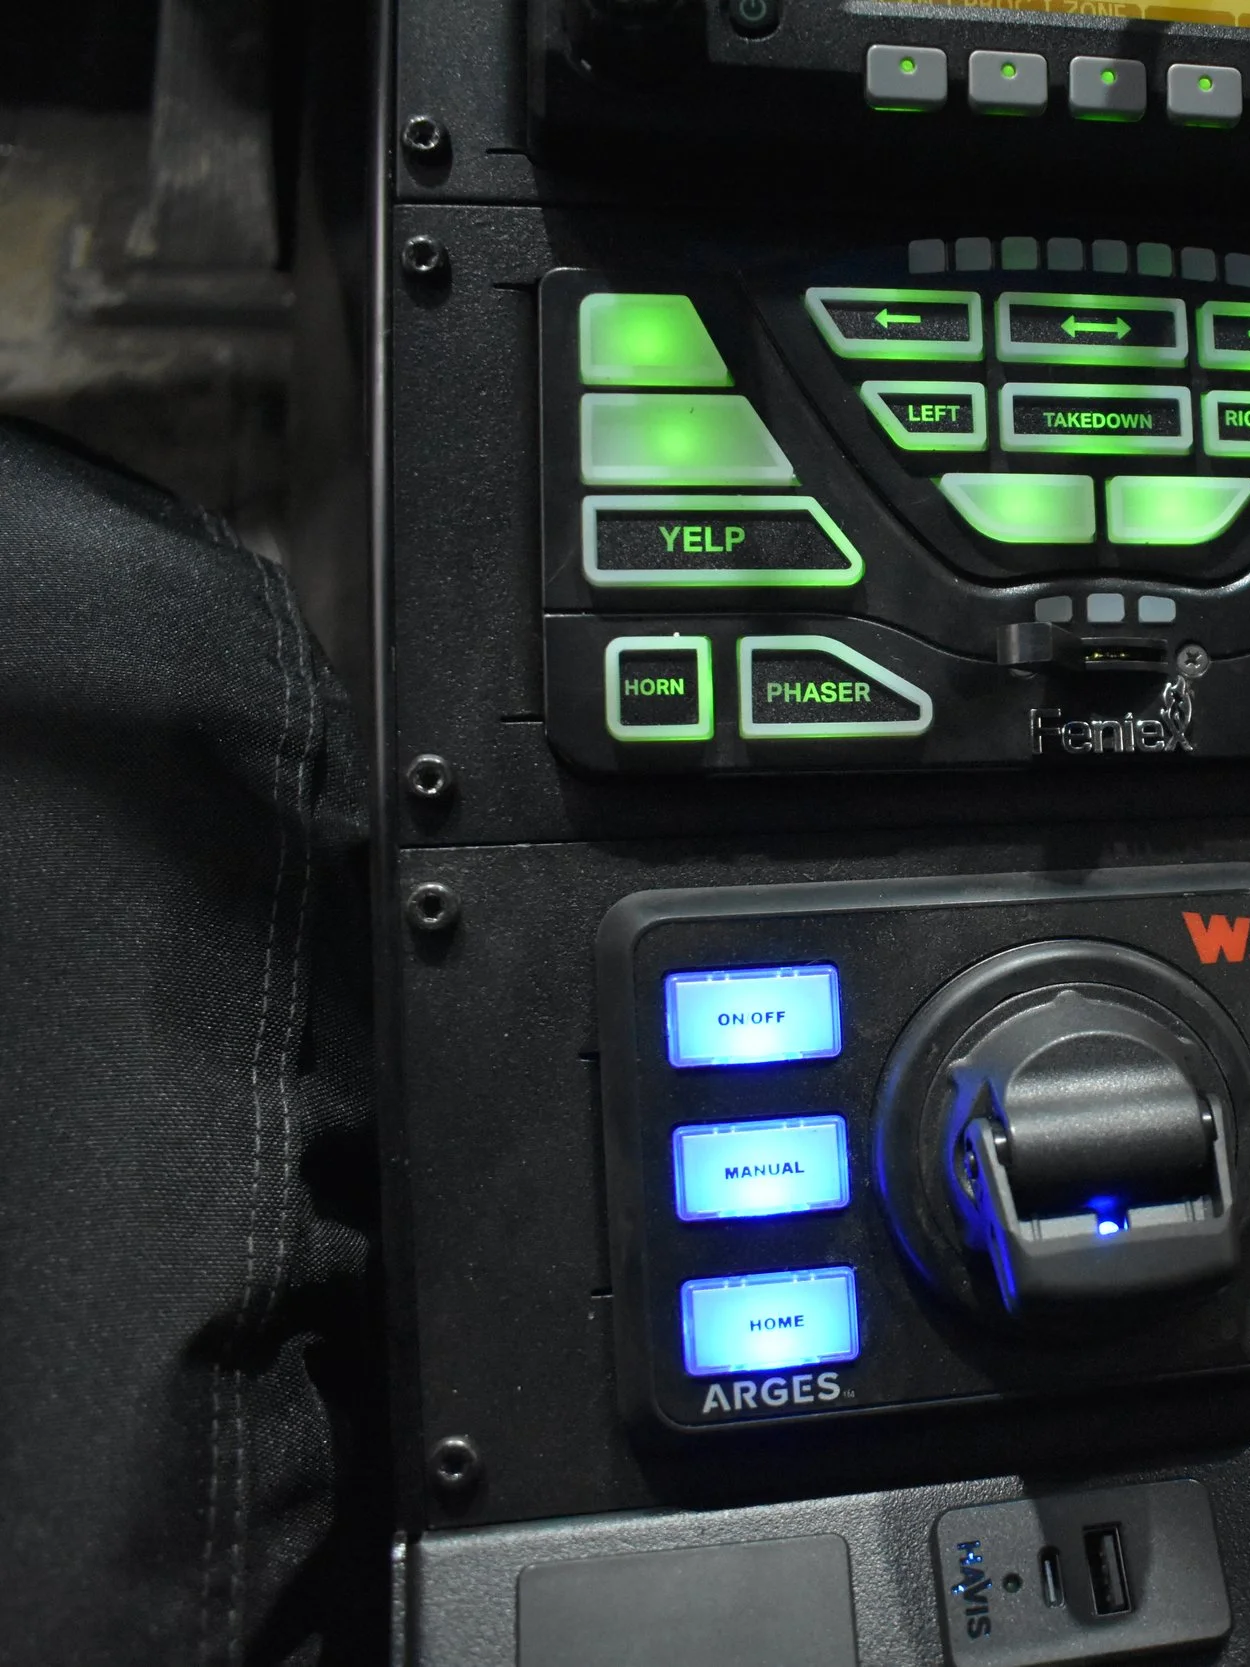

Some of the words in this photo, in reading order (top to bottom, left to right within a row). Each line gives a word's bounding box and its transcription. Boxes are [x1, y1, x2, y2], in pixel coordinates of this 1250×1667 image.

[1063, 0, 1127, 17] ZONE
[907, 403, 960, 424] LEFT
[1043, 411, 1154, 431] TAKEDOWN
[659, 525, 746, 553] YELP
[624, 677, 685, 697] HORN
[766, 682, 872, 704] PHASER
[724, 1161, 806, 1180] MANUAL
[749, 1314, 805, 1332] HOME
[702, 1371, 841, 1416] ARGES
[951, 1540, 993, 1641] HAVIS
